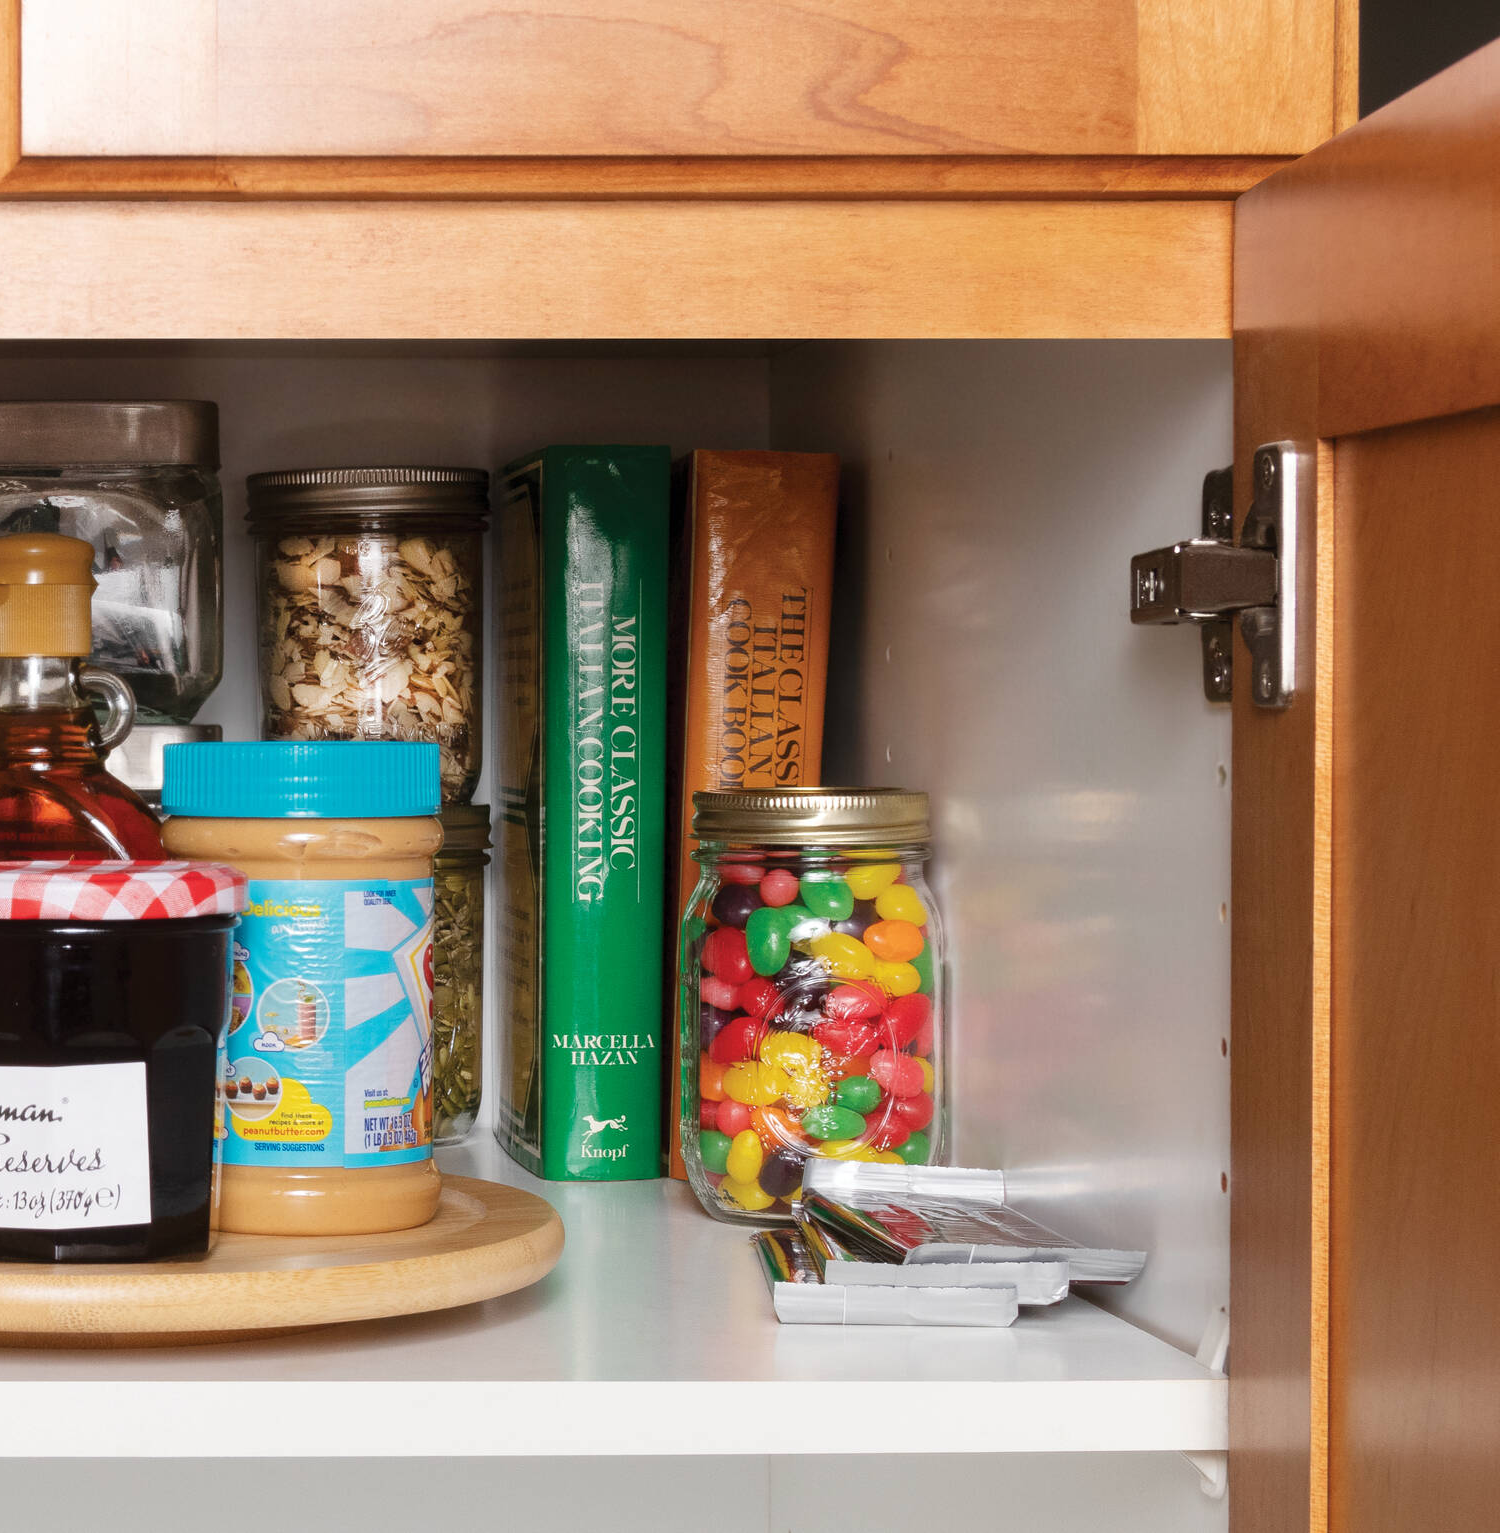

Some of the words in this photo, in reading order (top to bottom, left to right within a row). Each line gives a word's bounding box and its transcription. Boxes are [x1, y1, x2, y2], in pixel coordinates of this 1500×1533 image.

[576, 582, 604, 733] ITALIAN
[723, 598, 752, 697] COOK
[779, 587, 807, 664] THE
[610, 616, 636, 717] MORE
[748, 624, 778, 776] ITALIAN
[775, 668, 803, 787] CLASSI
[577, 737, 604, 902] COOKING
[610, 725, 636, 870] CLASSIC
[552, 1034, 655, 1049] MARCELLA
[570, 1050, 639, 1066] HAZAN
[243, 1127, 325, 1137] peanutbutter.com
[254, 1142, 281, 1151] SERVING
[282, 1143, 325, 1152] SUGGESTIONS
[364, 1117, 377, 1132] NET
[379, 1116, 389, 1131] WT
[373, 1131, 382, 1147] LB
[581, 1143, 629, 1161] Knopf
